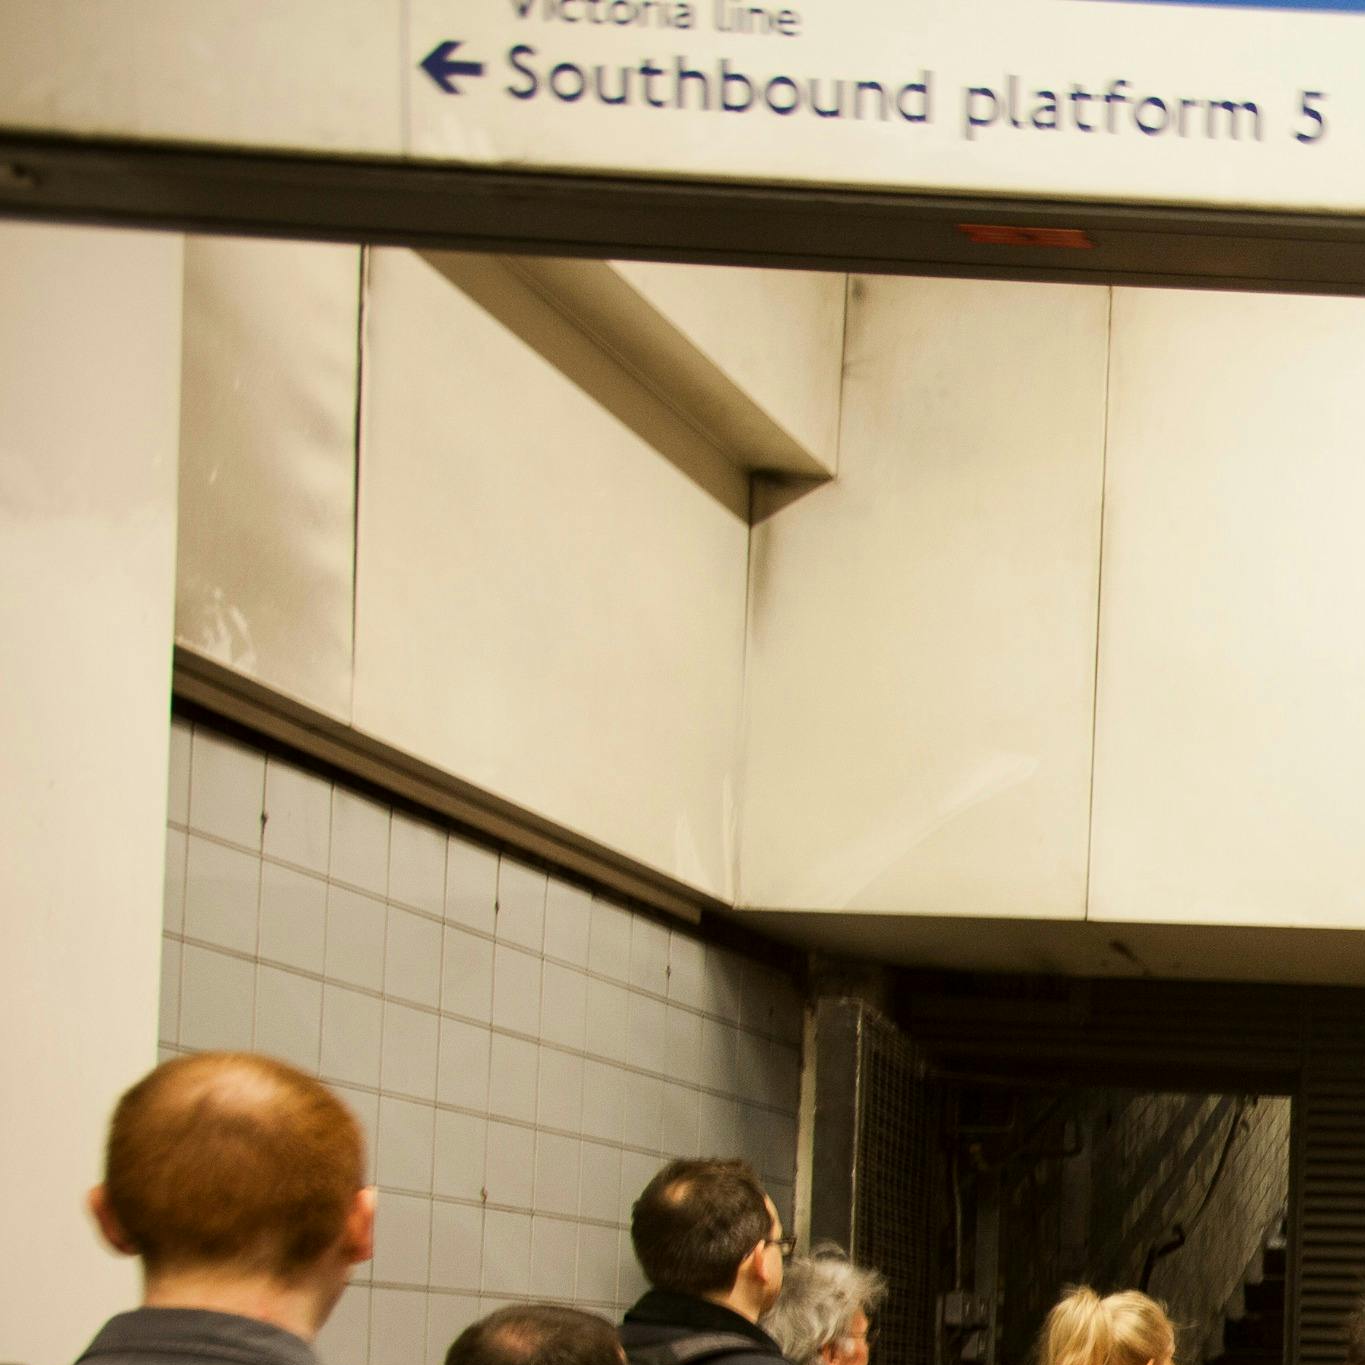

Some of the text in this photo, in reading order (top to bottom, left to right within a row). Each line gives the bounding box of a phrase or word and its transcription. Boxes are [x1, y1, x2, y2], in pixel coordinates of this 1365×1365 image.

[713, 0, 799, 37] line
[507, 43, 1329, 145] Southbound platform 5
